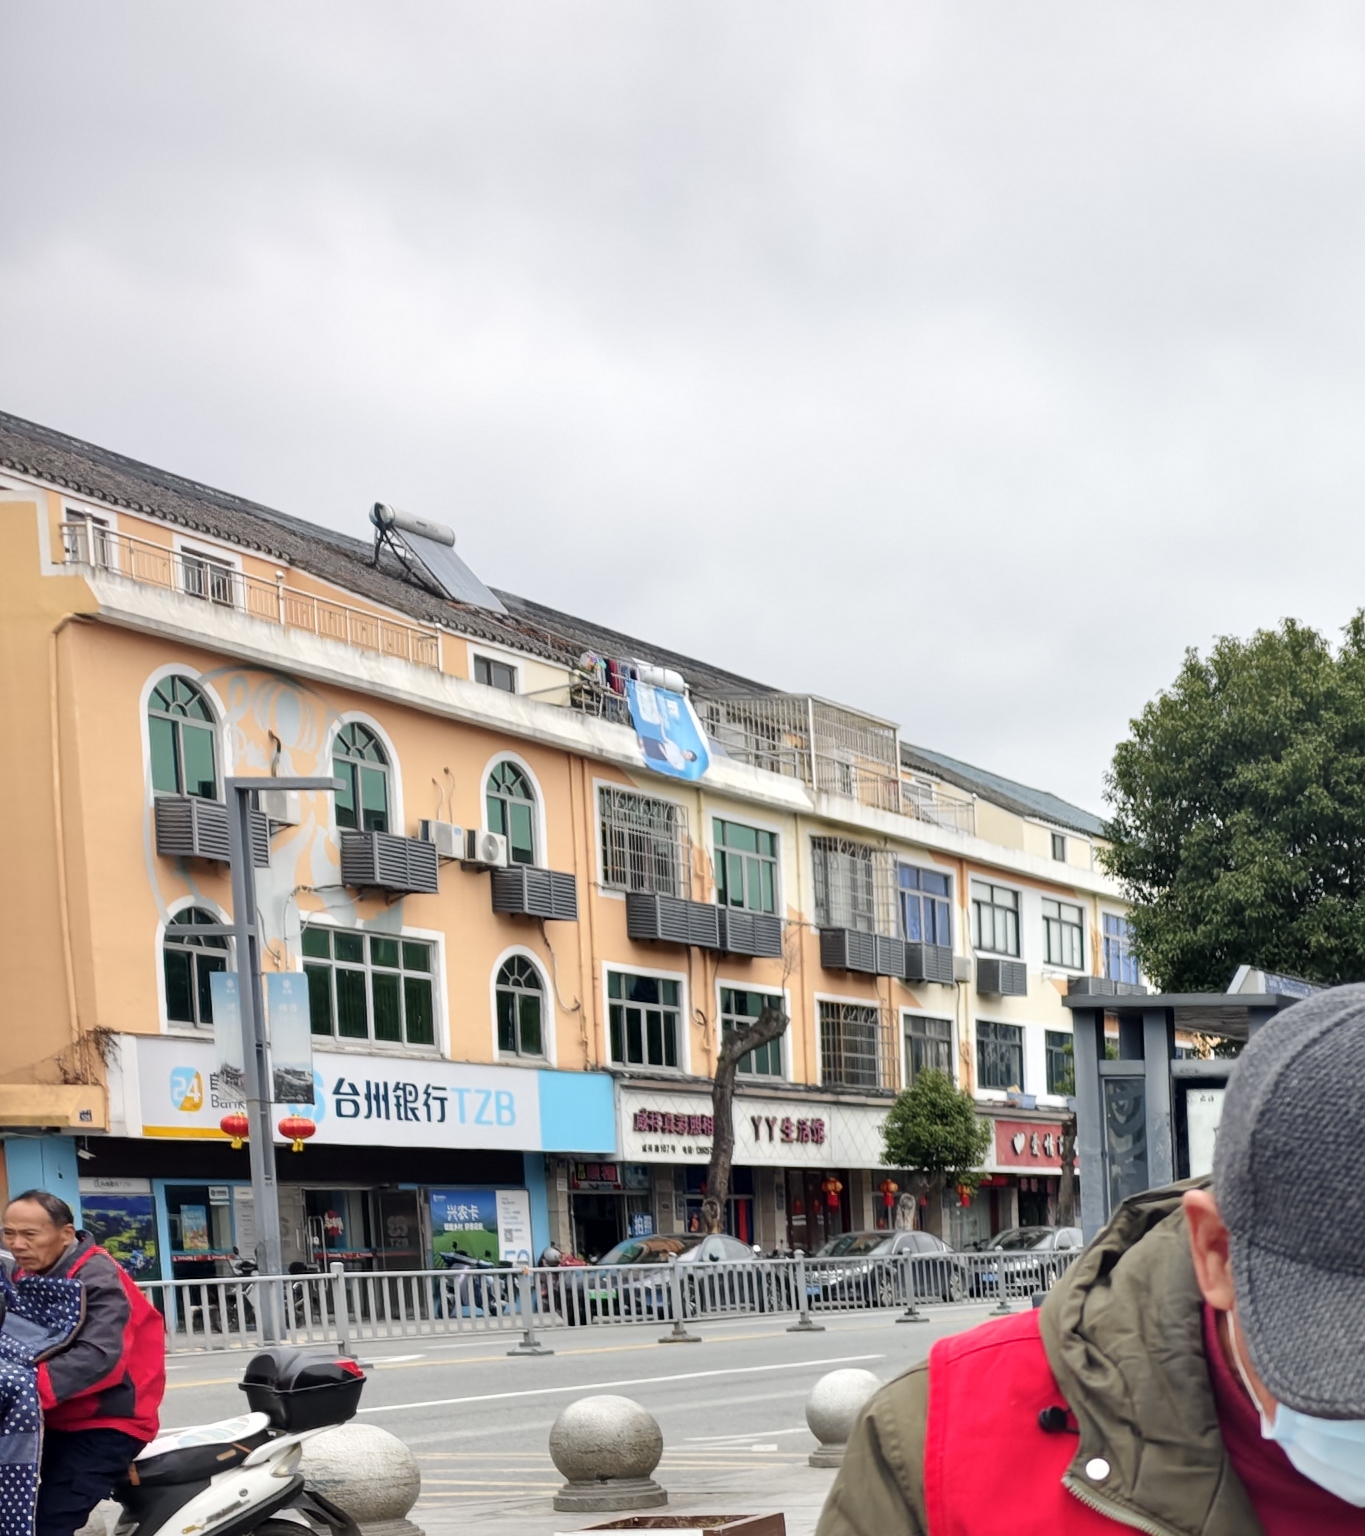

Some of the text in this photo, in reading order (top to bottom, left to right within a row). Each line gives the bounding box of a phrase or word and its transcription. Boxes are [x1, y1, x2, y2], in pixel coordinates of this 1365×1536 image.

[332, 1077, 517, 1127] 台州银行 TZB
